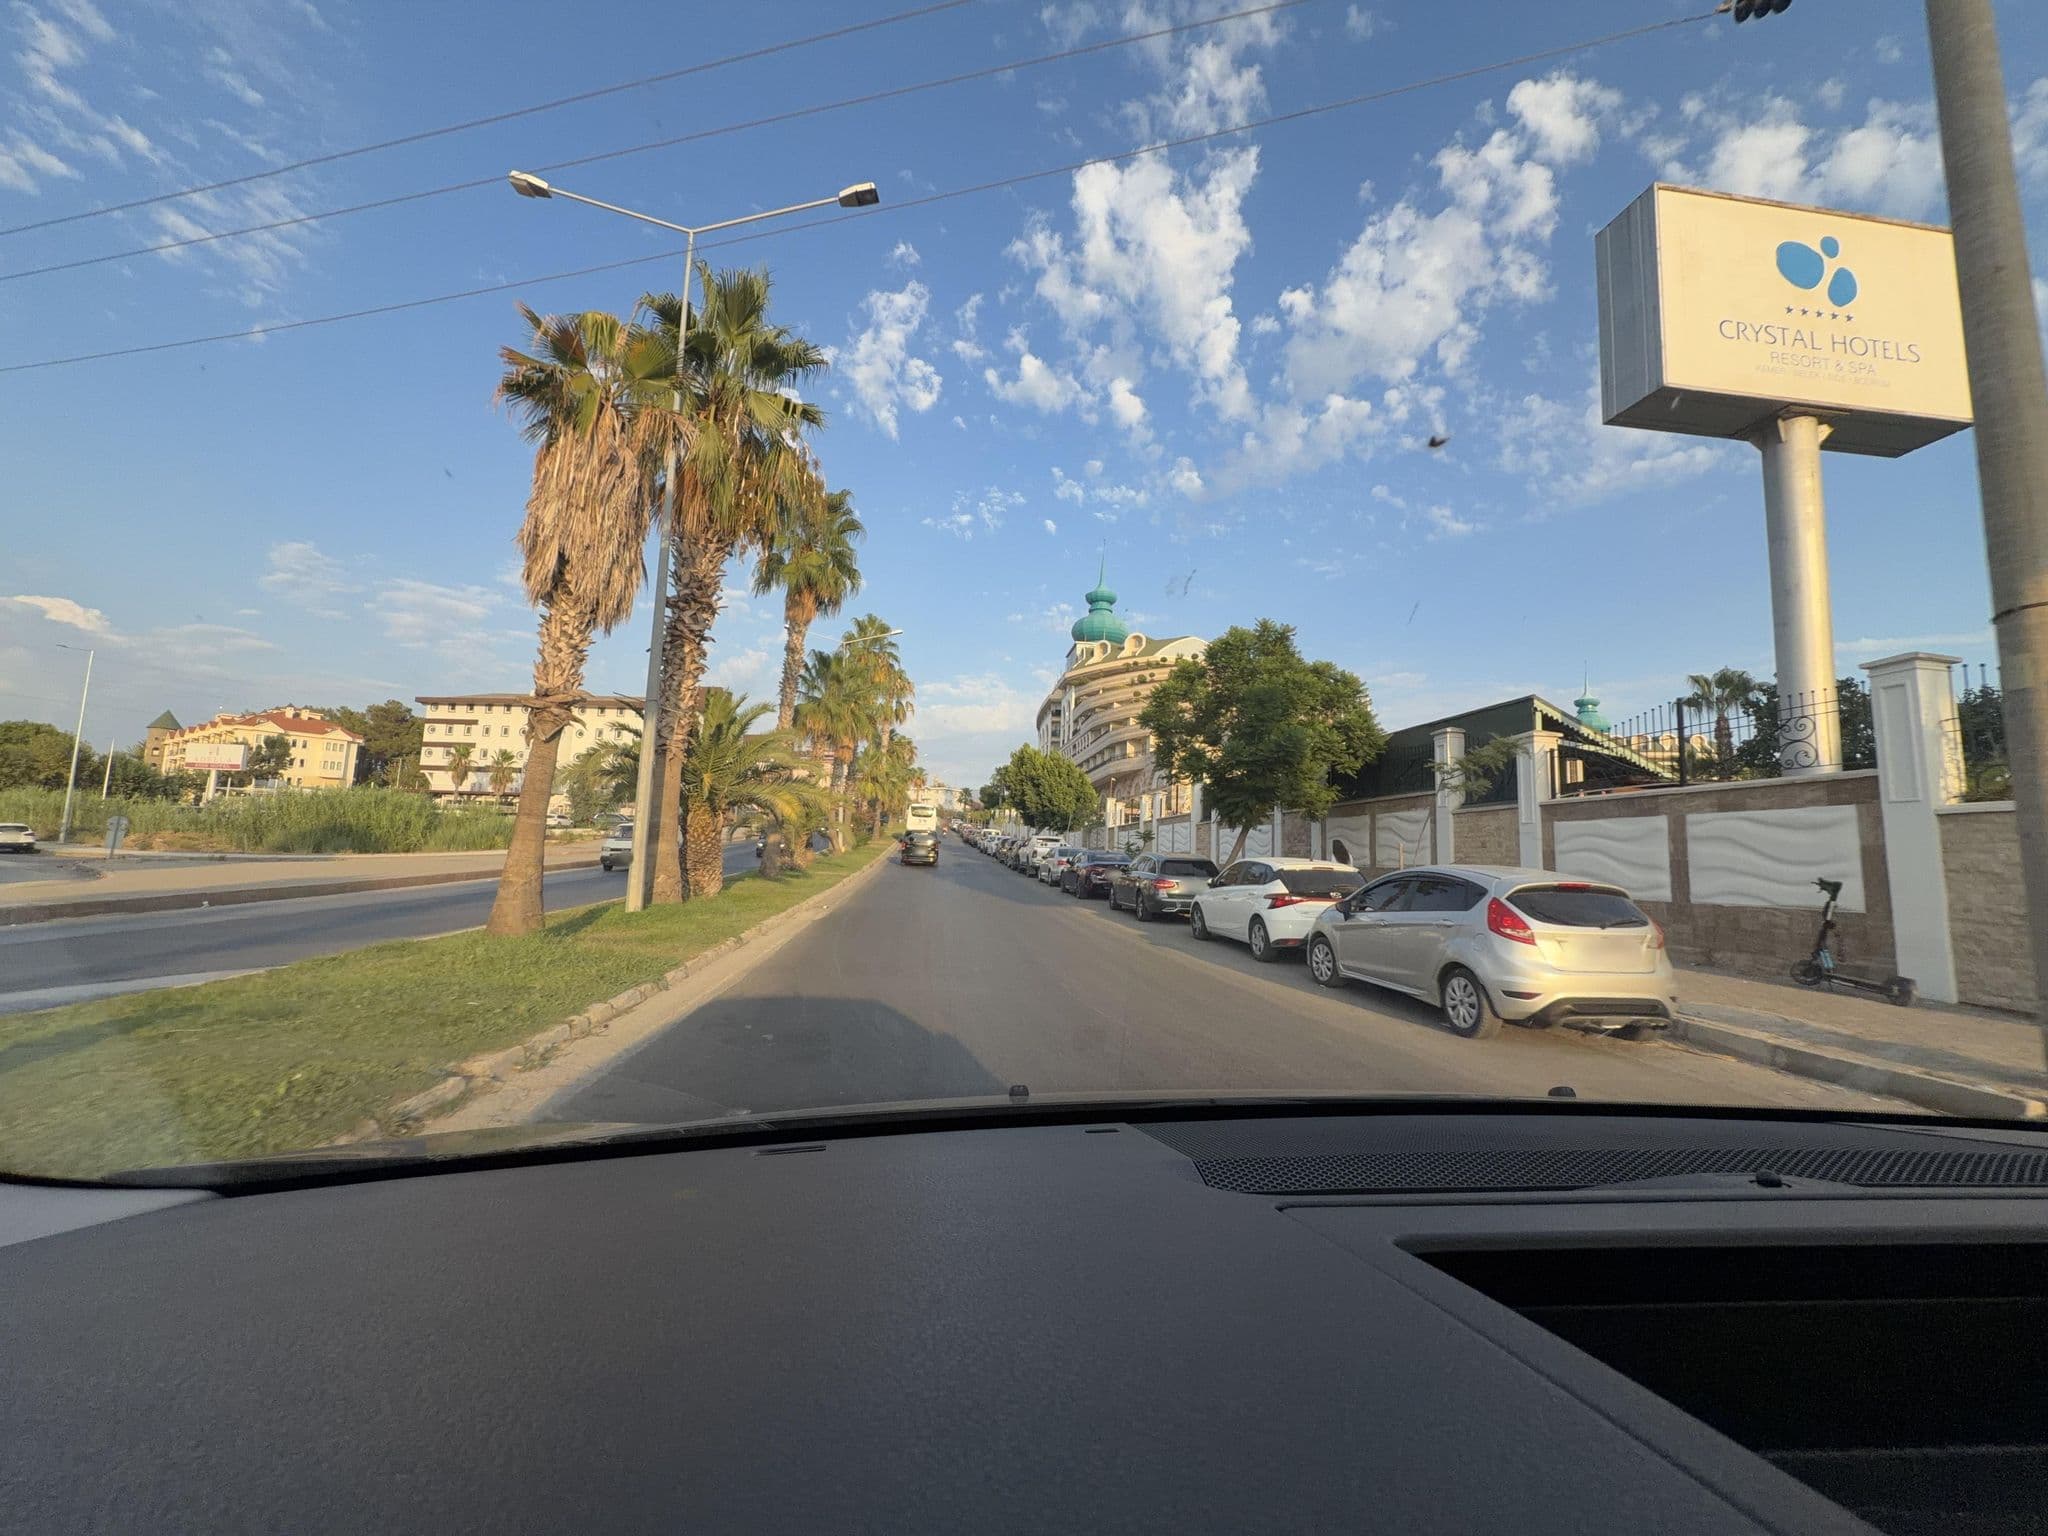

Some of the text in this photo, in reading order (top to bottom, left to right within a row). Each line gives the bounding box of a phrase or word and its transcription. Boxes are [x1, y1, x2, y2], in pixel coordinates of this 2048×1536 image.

[1719, 320, 1921, 363] CRYSTAL HOTELS
[1770, 351, 1877, 376] RESORT & SPA
